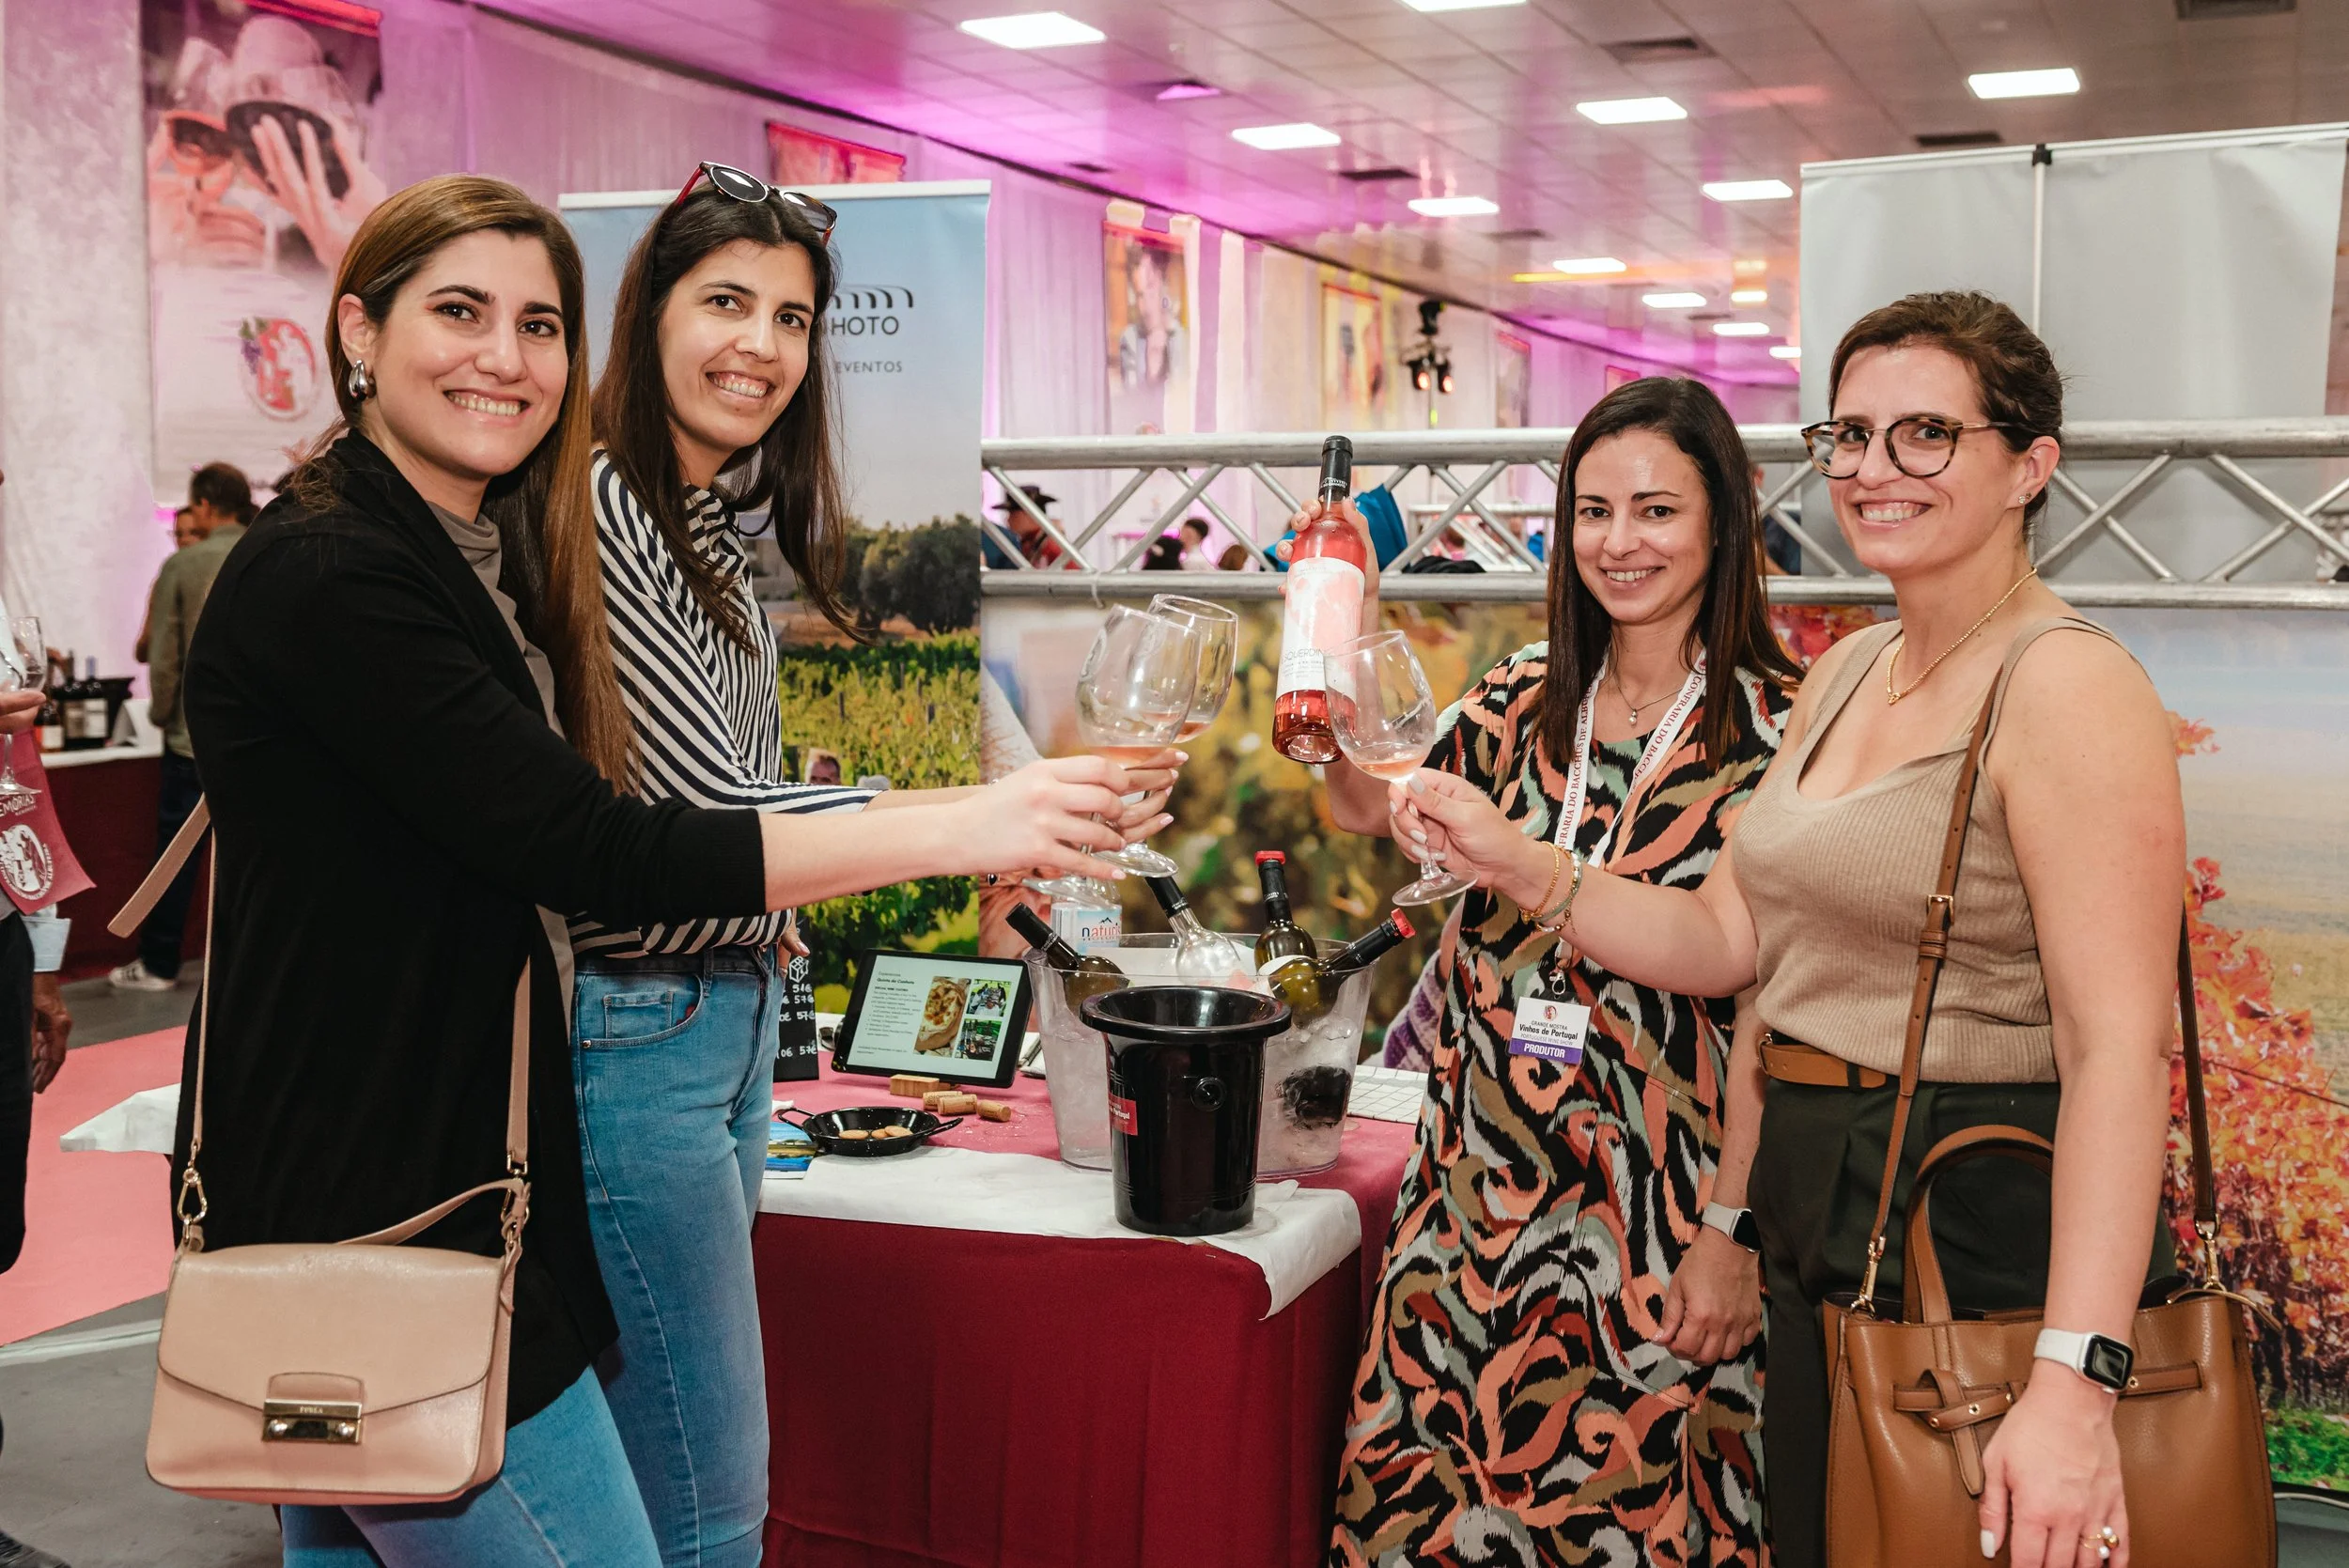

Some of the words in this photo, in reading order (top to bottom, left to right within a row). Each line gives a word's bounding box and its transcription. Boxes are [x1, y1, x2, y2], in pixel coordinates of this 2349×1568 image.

[831, 316, 899, 336] HOTO
[835, 360, 903, 374] EVENTOS
[1663, 675, 1702, 727] CONFRARIA
[1579, 728, 1587, 741] DE
[1655, 728, 1668, 744] DO
[1571, 742, 1584, 789] BACCHUS
[1568, 791, 1578, 808] DO
[1519, 1023, 1540, 1034] Vinhos
[1541, 1027, 1549, 1035] de
[1550, 1029, 1579, 1040] Portugal
[1523, 1042, 1566, 1059] PRODUTOR
